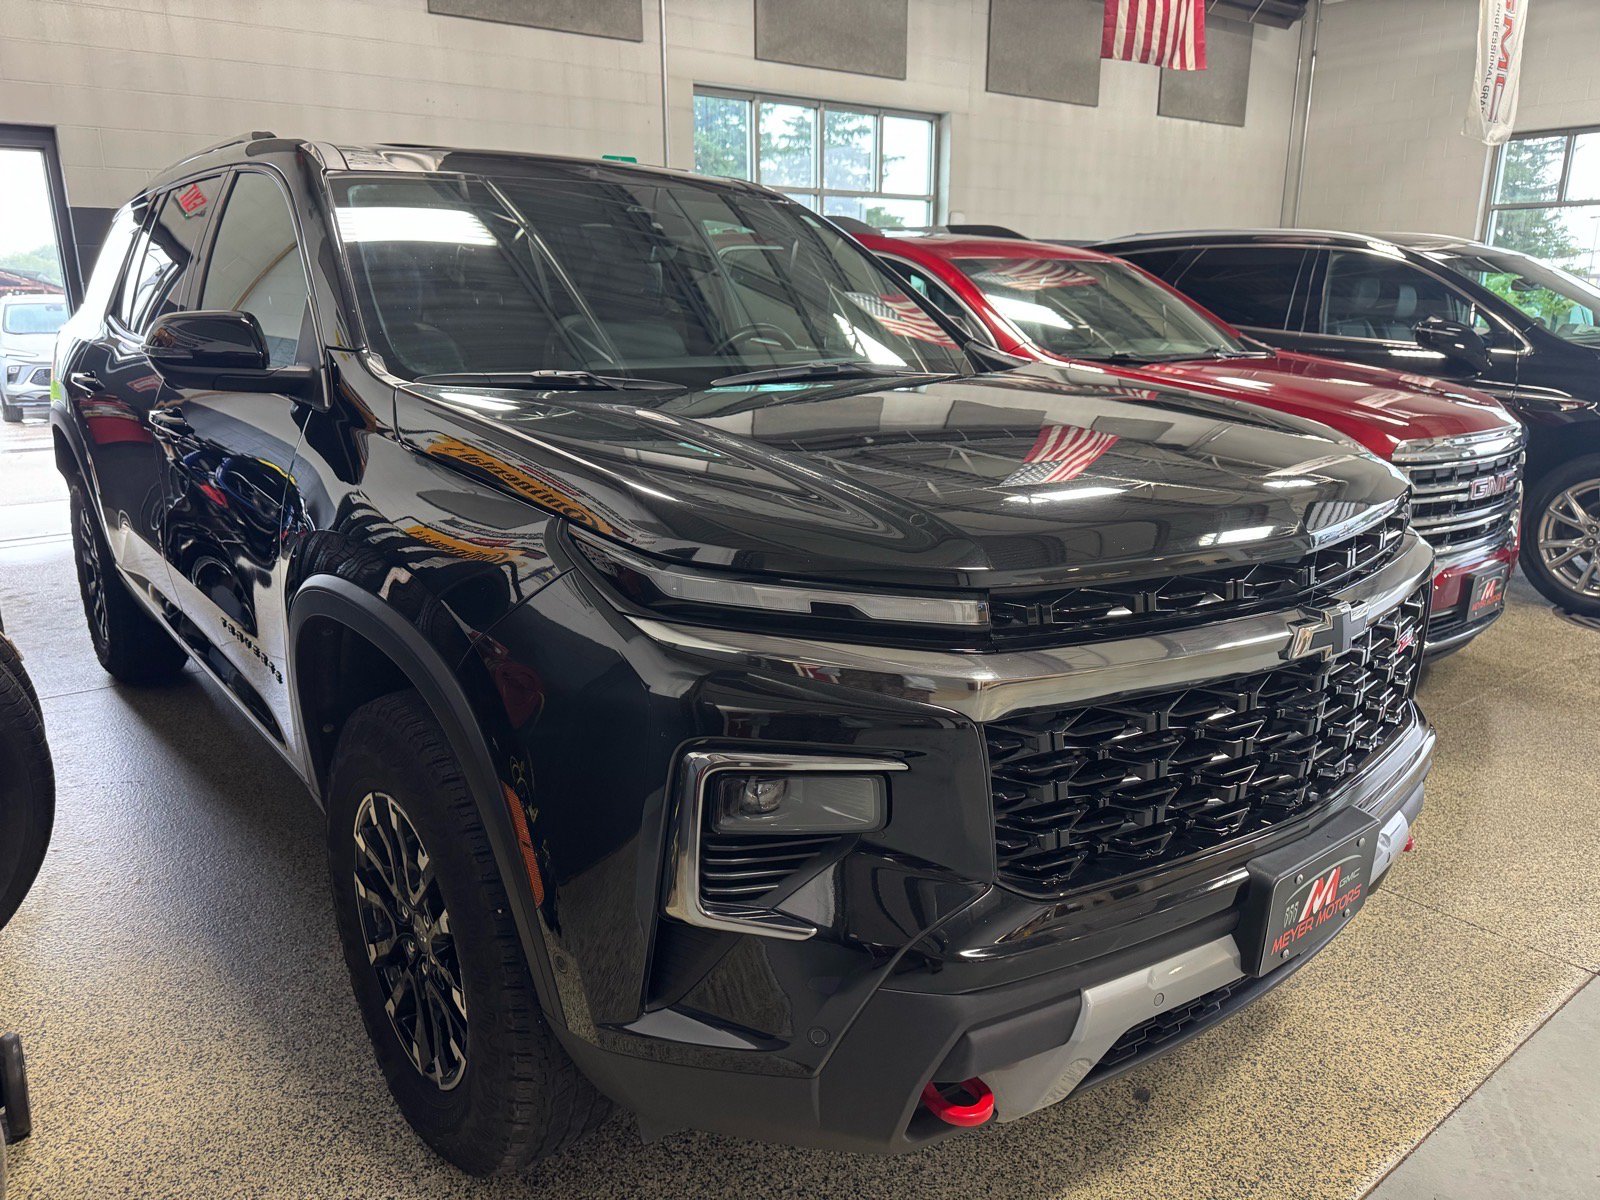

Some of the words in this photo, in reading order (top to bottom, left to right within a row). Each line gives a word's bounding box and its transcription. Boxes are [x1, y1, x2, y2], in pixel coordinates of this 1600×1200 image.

[1469, 470, 1517, 500] GMC
[1339, 867, 1361, 888] GMC
[1271, 918, 1314, 956] MEYER
[1316, 884, 1362, 928] MOTORS
